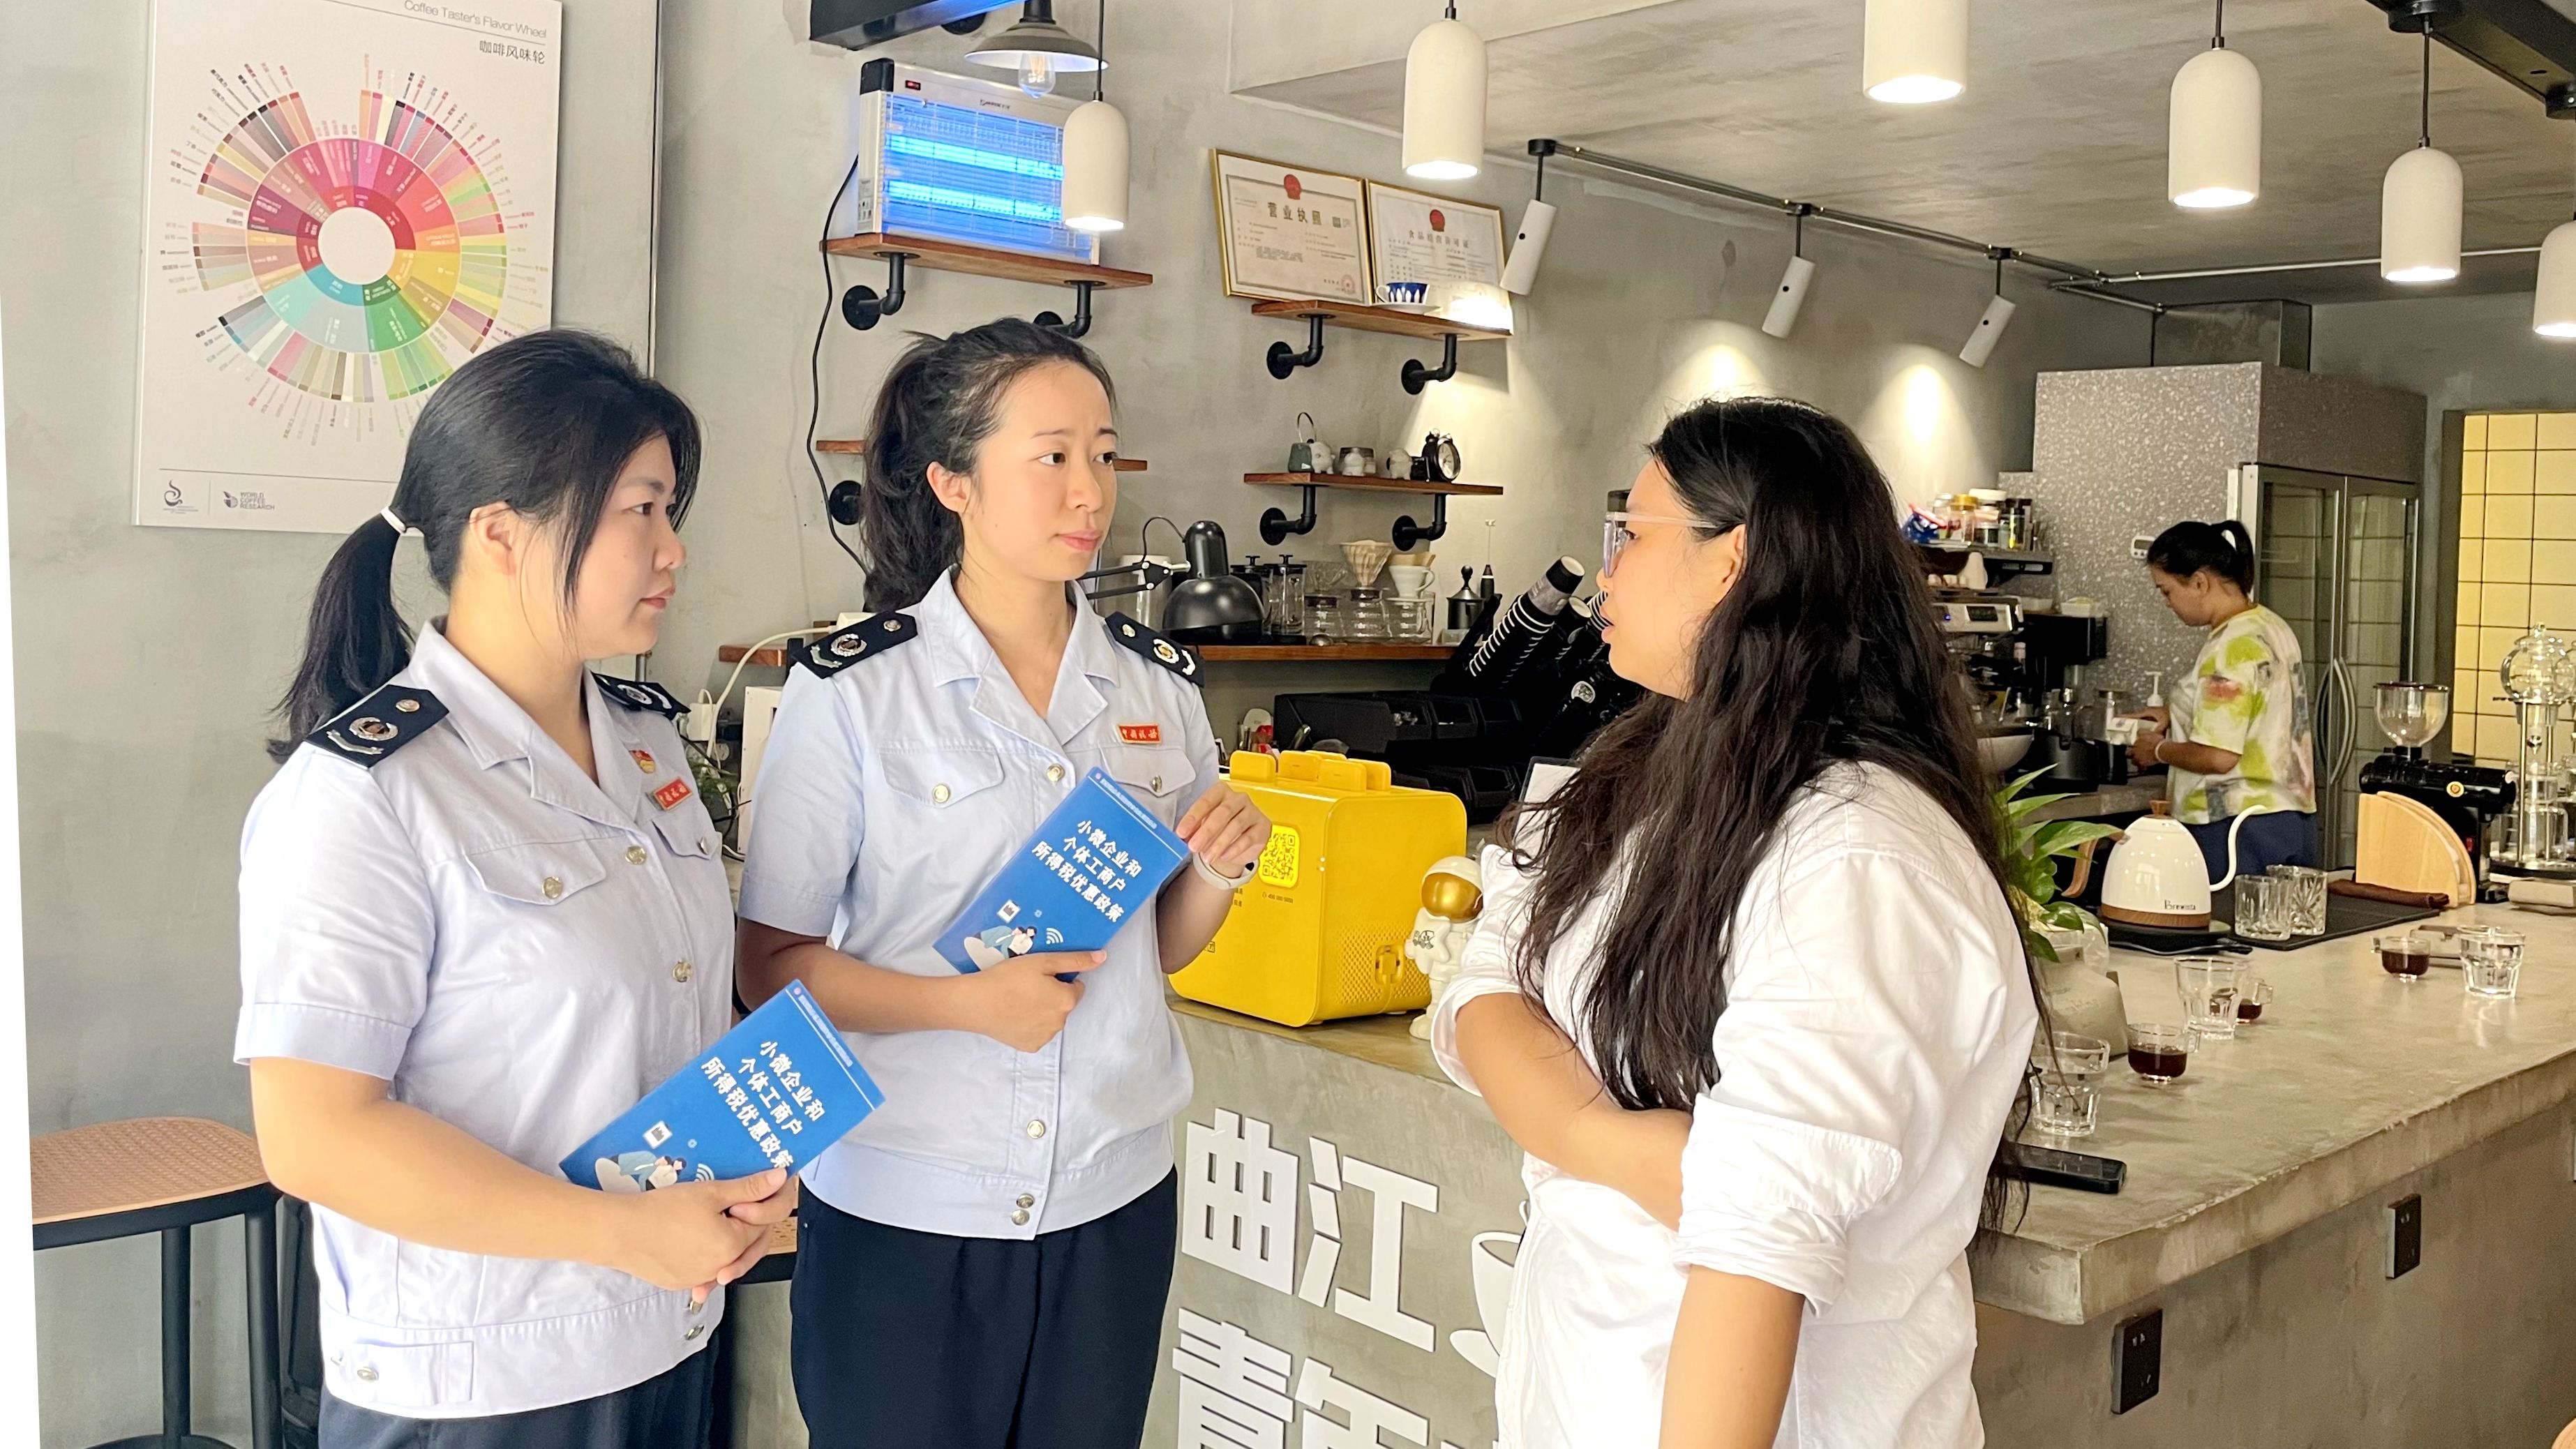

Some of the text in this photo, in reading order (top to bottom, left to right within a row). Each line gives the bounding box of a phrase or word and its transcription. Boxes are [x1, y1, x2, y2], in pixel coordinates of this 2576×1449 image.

[404, 0, 547, 38] Coffee Taster's Flavor Wheel
[479, 40, 546, 64] 咖啡风味轮
[1031, 841, 1125, 922] 所得税优惠政策
[1063, 836, 1126, 891] 个体工商户
[1077, 820, 1142, 878] 小微企业和
[701, 1056, 794, 1168] 所得税优惠政策
[738, 1058, 802, 1134] 个体工商户
[760, 1042, 825, 1121] 小微企业和
[1181, 1107, 1439, 1353] 曲江
